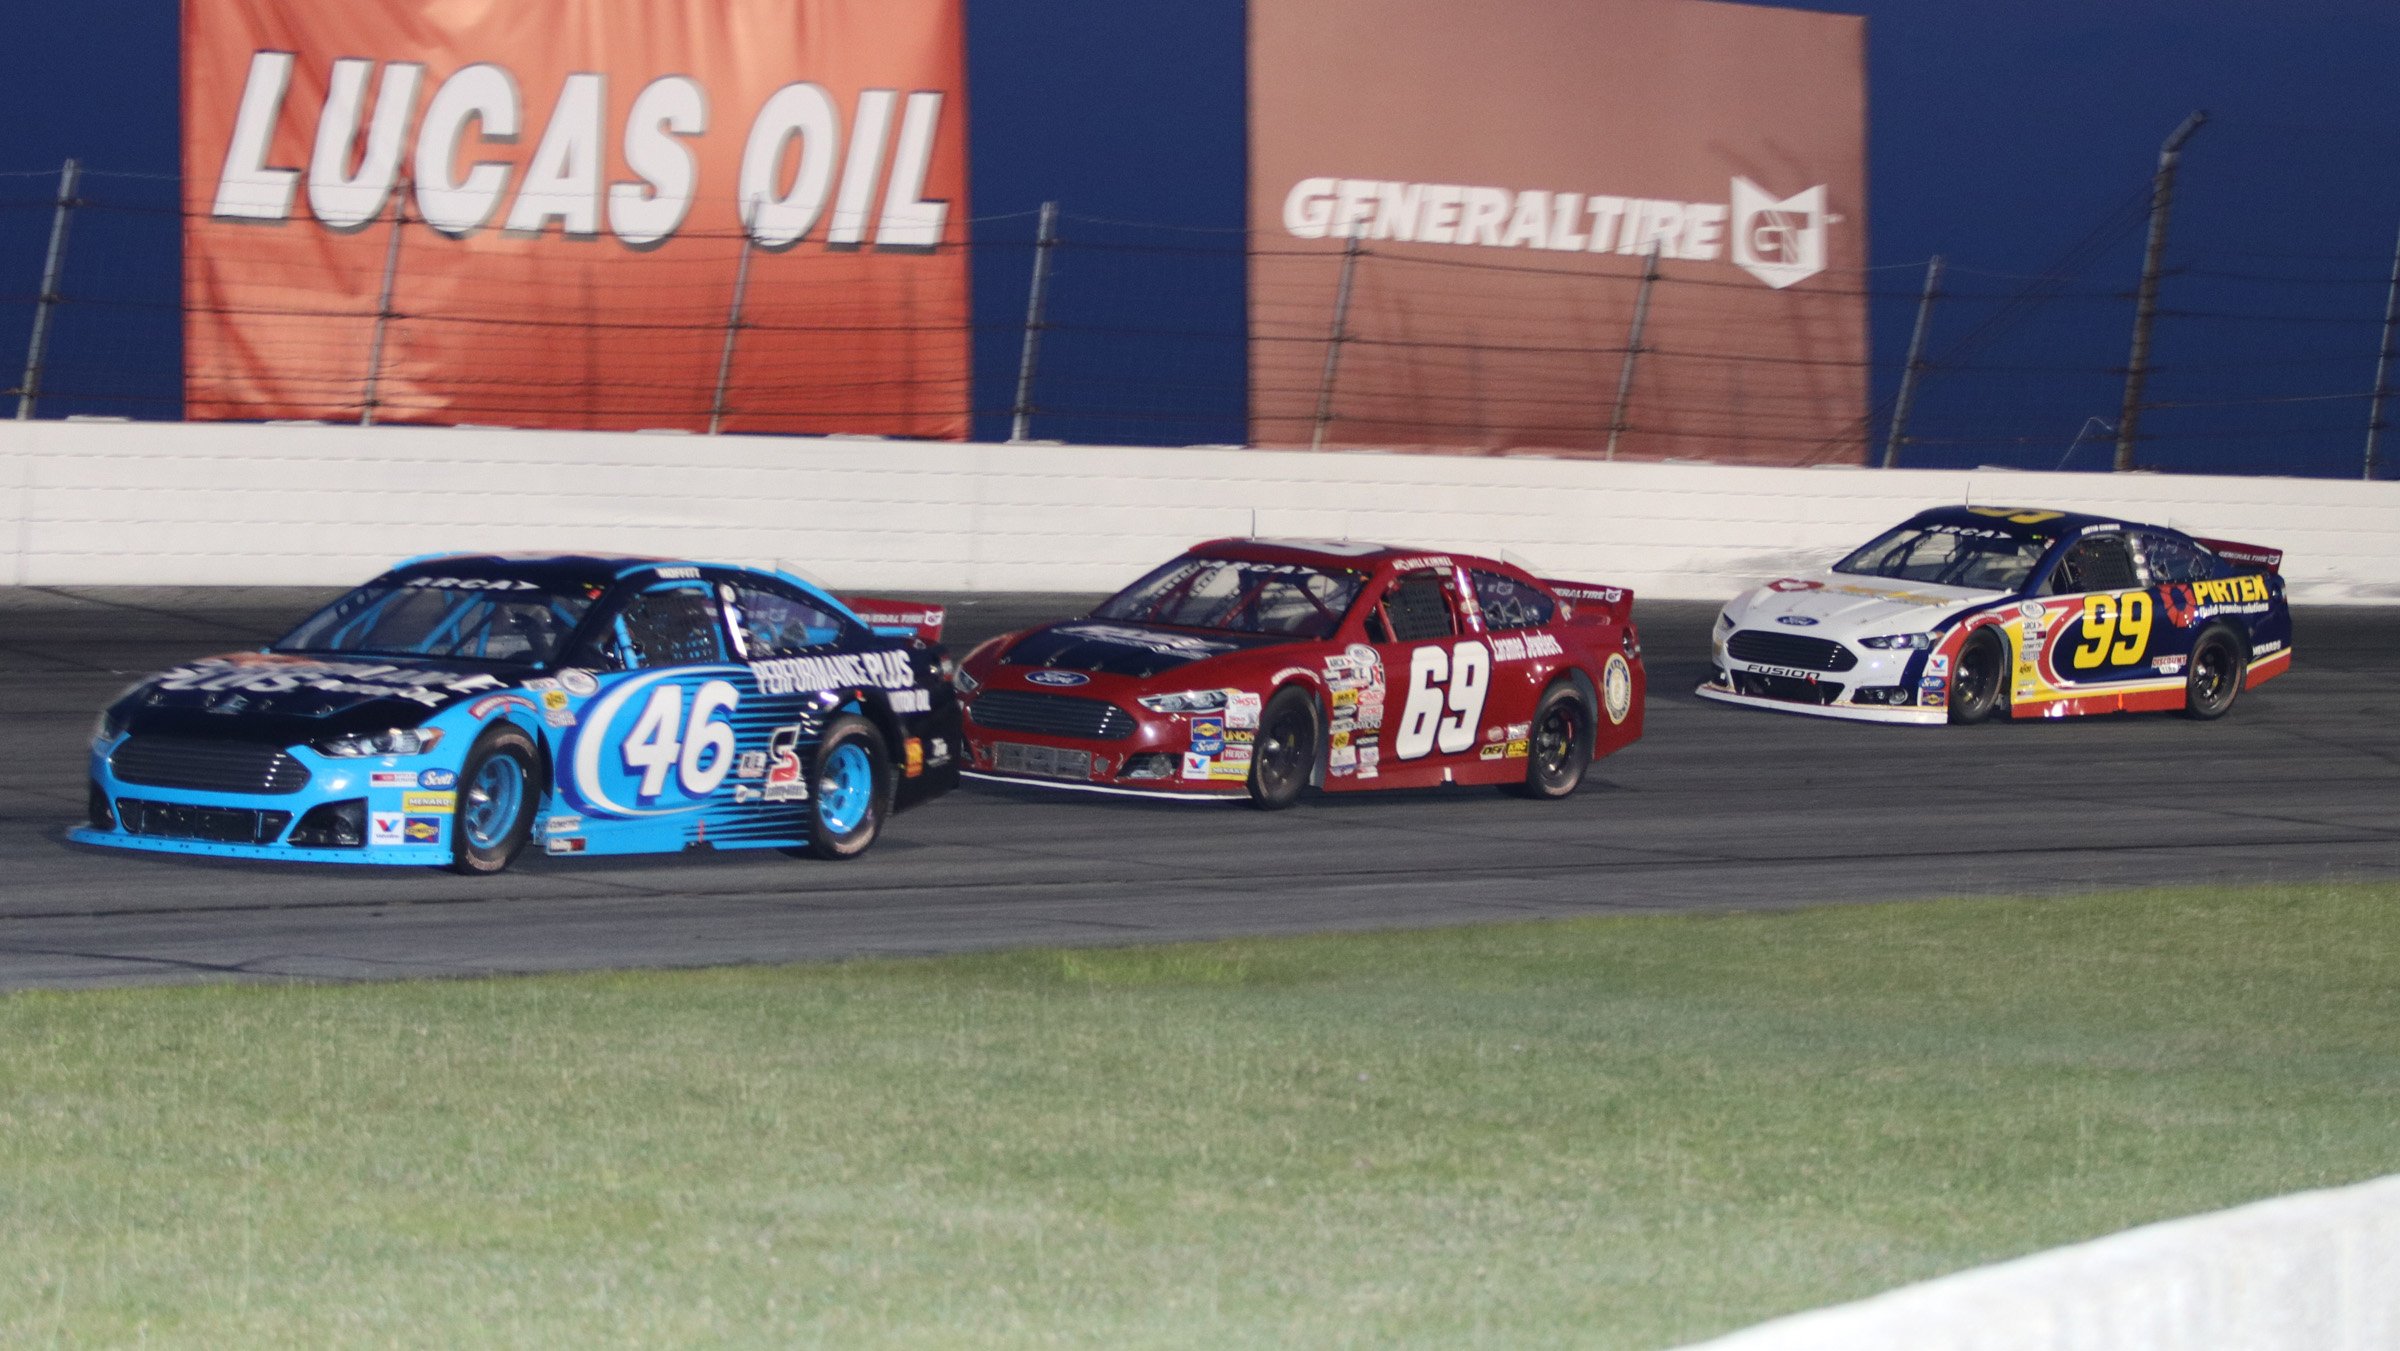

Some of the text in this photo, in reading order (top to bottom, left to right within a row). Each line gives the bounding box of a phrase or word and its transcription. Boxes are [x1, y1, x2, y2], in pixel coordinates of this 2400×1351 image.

[211, 50, 949, 252] LUCAS OIL
[2073, 591, 2153, 669] 99
[749, 649, 917, 694] PERFORMANCE PLUS
[1396, 641, 1490, 760] 69
[1747, 664, 1820, 680] FUSION
[425, 771, 454, 785] Scott
[621, 680, 739, 798] 46
